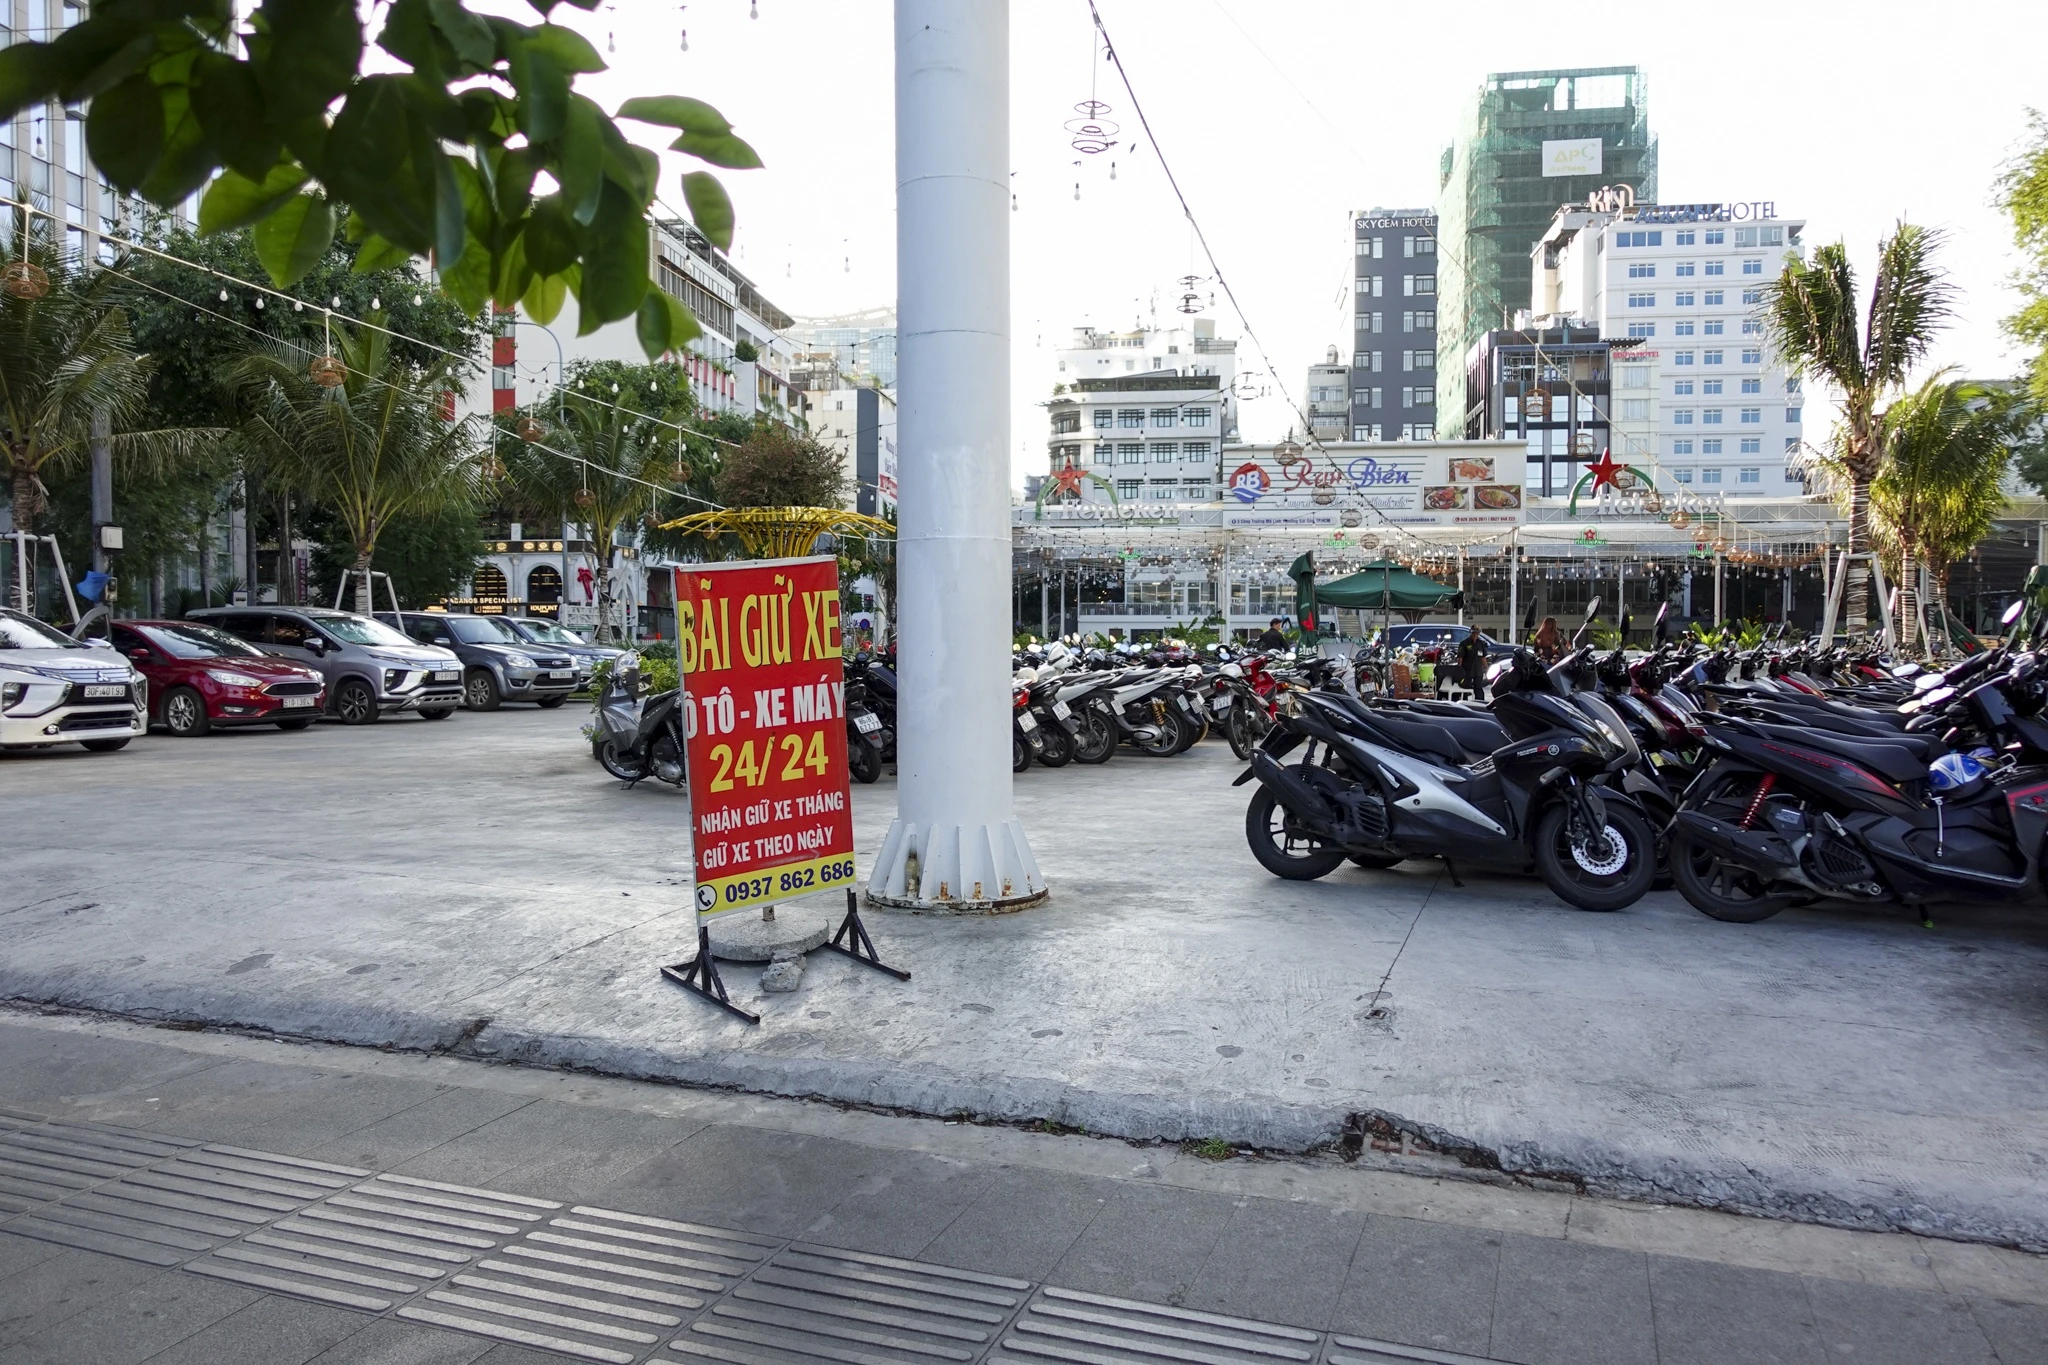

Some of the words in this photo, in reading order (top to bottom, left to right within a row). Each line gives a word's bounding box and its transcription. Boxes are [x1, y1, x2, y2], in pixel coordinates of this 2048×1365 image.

[1554, 143, 1596, 162] APC
[1402, 217, 1435, 228] HOTEL
[1719, 202, 1778, 222] HOTEL
[1236, 471, 1260, 489] RB
[1347, 457, 1410, 490] Biển
[1060, 499, 1180, 519] Heineken
[677, 578, 732, 674] BÃI
[740, 574, 794, 668] GIỮ
[802, 590, 843, 661] XE
[702, 686, 735, 736] TÔ
[754, 688, 787, 728] XE
[793, 674, 845, 724] MÁY
[701, 805, 741, 834] NHẬN
[745, 799, 770, 826] GIỮ
[774, 800, 792, 821] XE
[796, 789, 844, 816] THÁNG
[703, 841, 728, 869] GIỮ
[731, 842, 751, 864] XE
[754, 834, 793, 858] THEO
[797, 823, 834, 851] NGÀY
[725, 877, 773, 903] 0937
[780, 868, 814, 892] 862
[820, 860, 854, 882] 686
